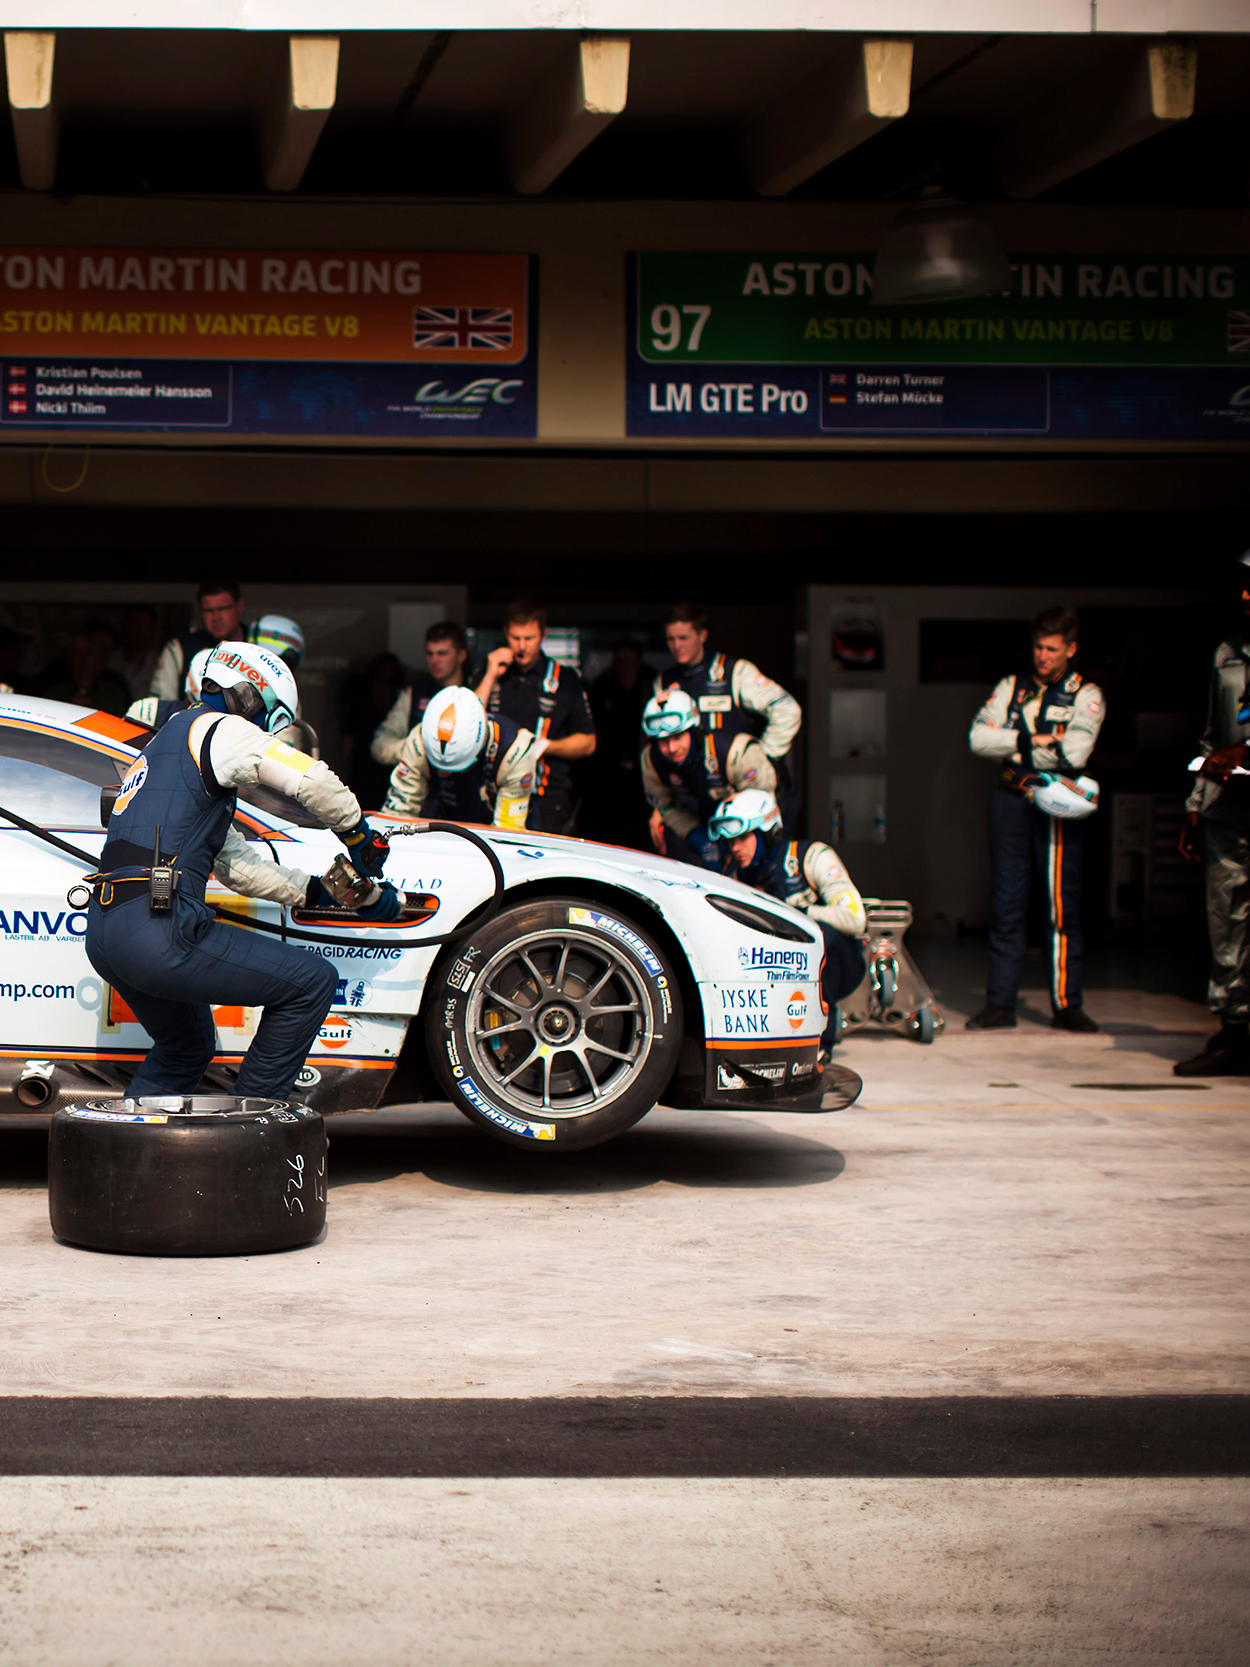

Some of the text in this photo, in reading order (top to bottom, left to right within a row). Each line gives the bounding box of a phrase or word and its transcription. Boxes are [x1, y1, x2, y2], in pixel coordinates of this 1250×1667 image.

[78, 256, 248, 292] MARTIN
[261, 258, 423, 295] RACING
[742, 261, 874, 296] ASTON
[1077, 264, 1236, 299] RACING
[81, 311, 187, 335] MARTIN
[194, 312, 318, 337] VANTAGE
[324, 315, 360, 338] V8
[650, 303, 713, 353] 97
[804, 317, 1176, 342] ASTON MARTIN VANTAGE V8
[36, 365, 144, 380] Kristian Poulsen
[855, 373, 945, 387] Darren Turner
[36, 383, 76, 397] David
[154, 385, 213, 400] Hansson
[649, 382, 809, 415] LM GTE Pro
[856, 391, 900, 405] Stefan
[36, 401, 69, 415] Nicki
[259, 654, 283, 678] uvex
[598, 916, 661, 971] MICHELIN
[751, 947, 808, 971] Hanergy
[721, 989, 769, 1009] JYSKE
[787, 1004, 808, 1016] Gulf
[318, 1027, 353, 1039] Gulf
[724, 1014, 771, 1034] BANK
[461, 1083, 528, 1134] MICHELIN
